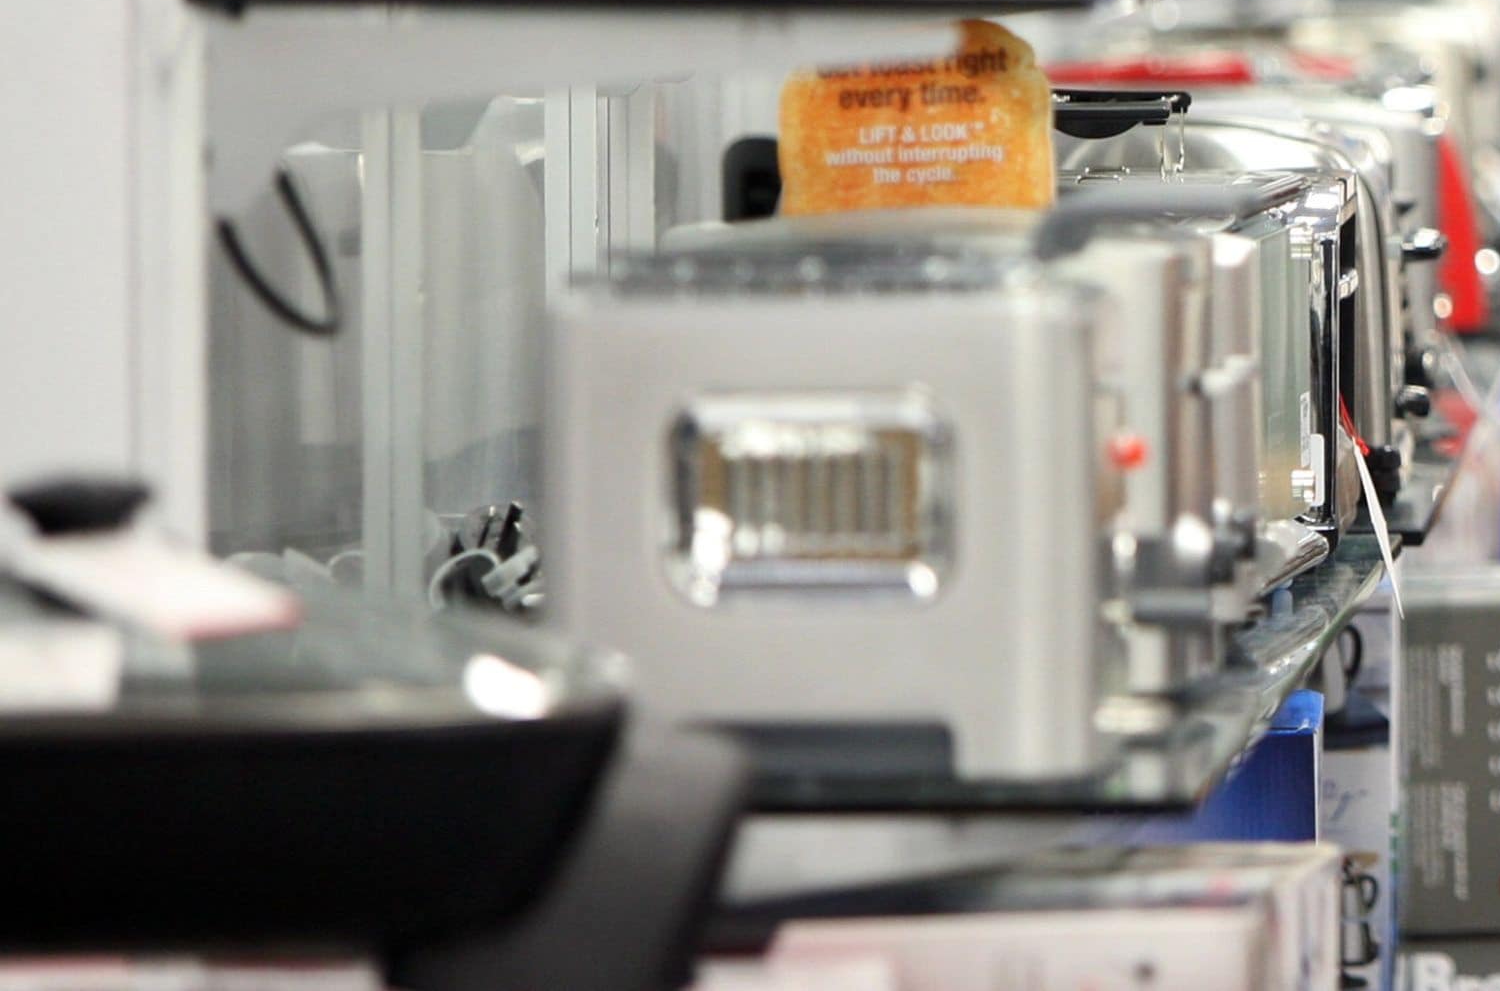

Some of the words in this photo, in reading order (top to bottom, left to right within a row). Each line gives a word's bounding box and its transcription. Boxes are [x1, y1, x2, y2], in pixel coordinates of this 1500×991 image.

[943, 47, 1006, 79] right
[839, 85, 911, 112] every
[920, 79, 986, 105] time.
[859, 124, 897, 145] LIFT
[902, 126, 915, 144] &
[824, 148, 894, 166] without
[900, 142, 1004, 163] interrupting
[874, 167, 900, 184] the
